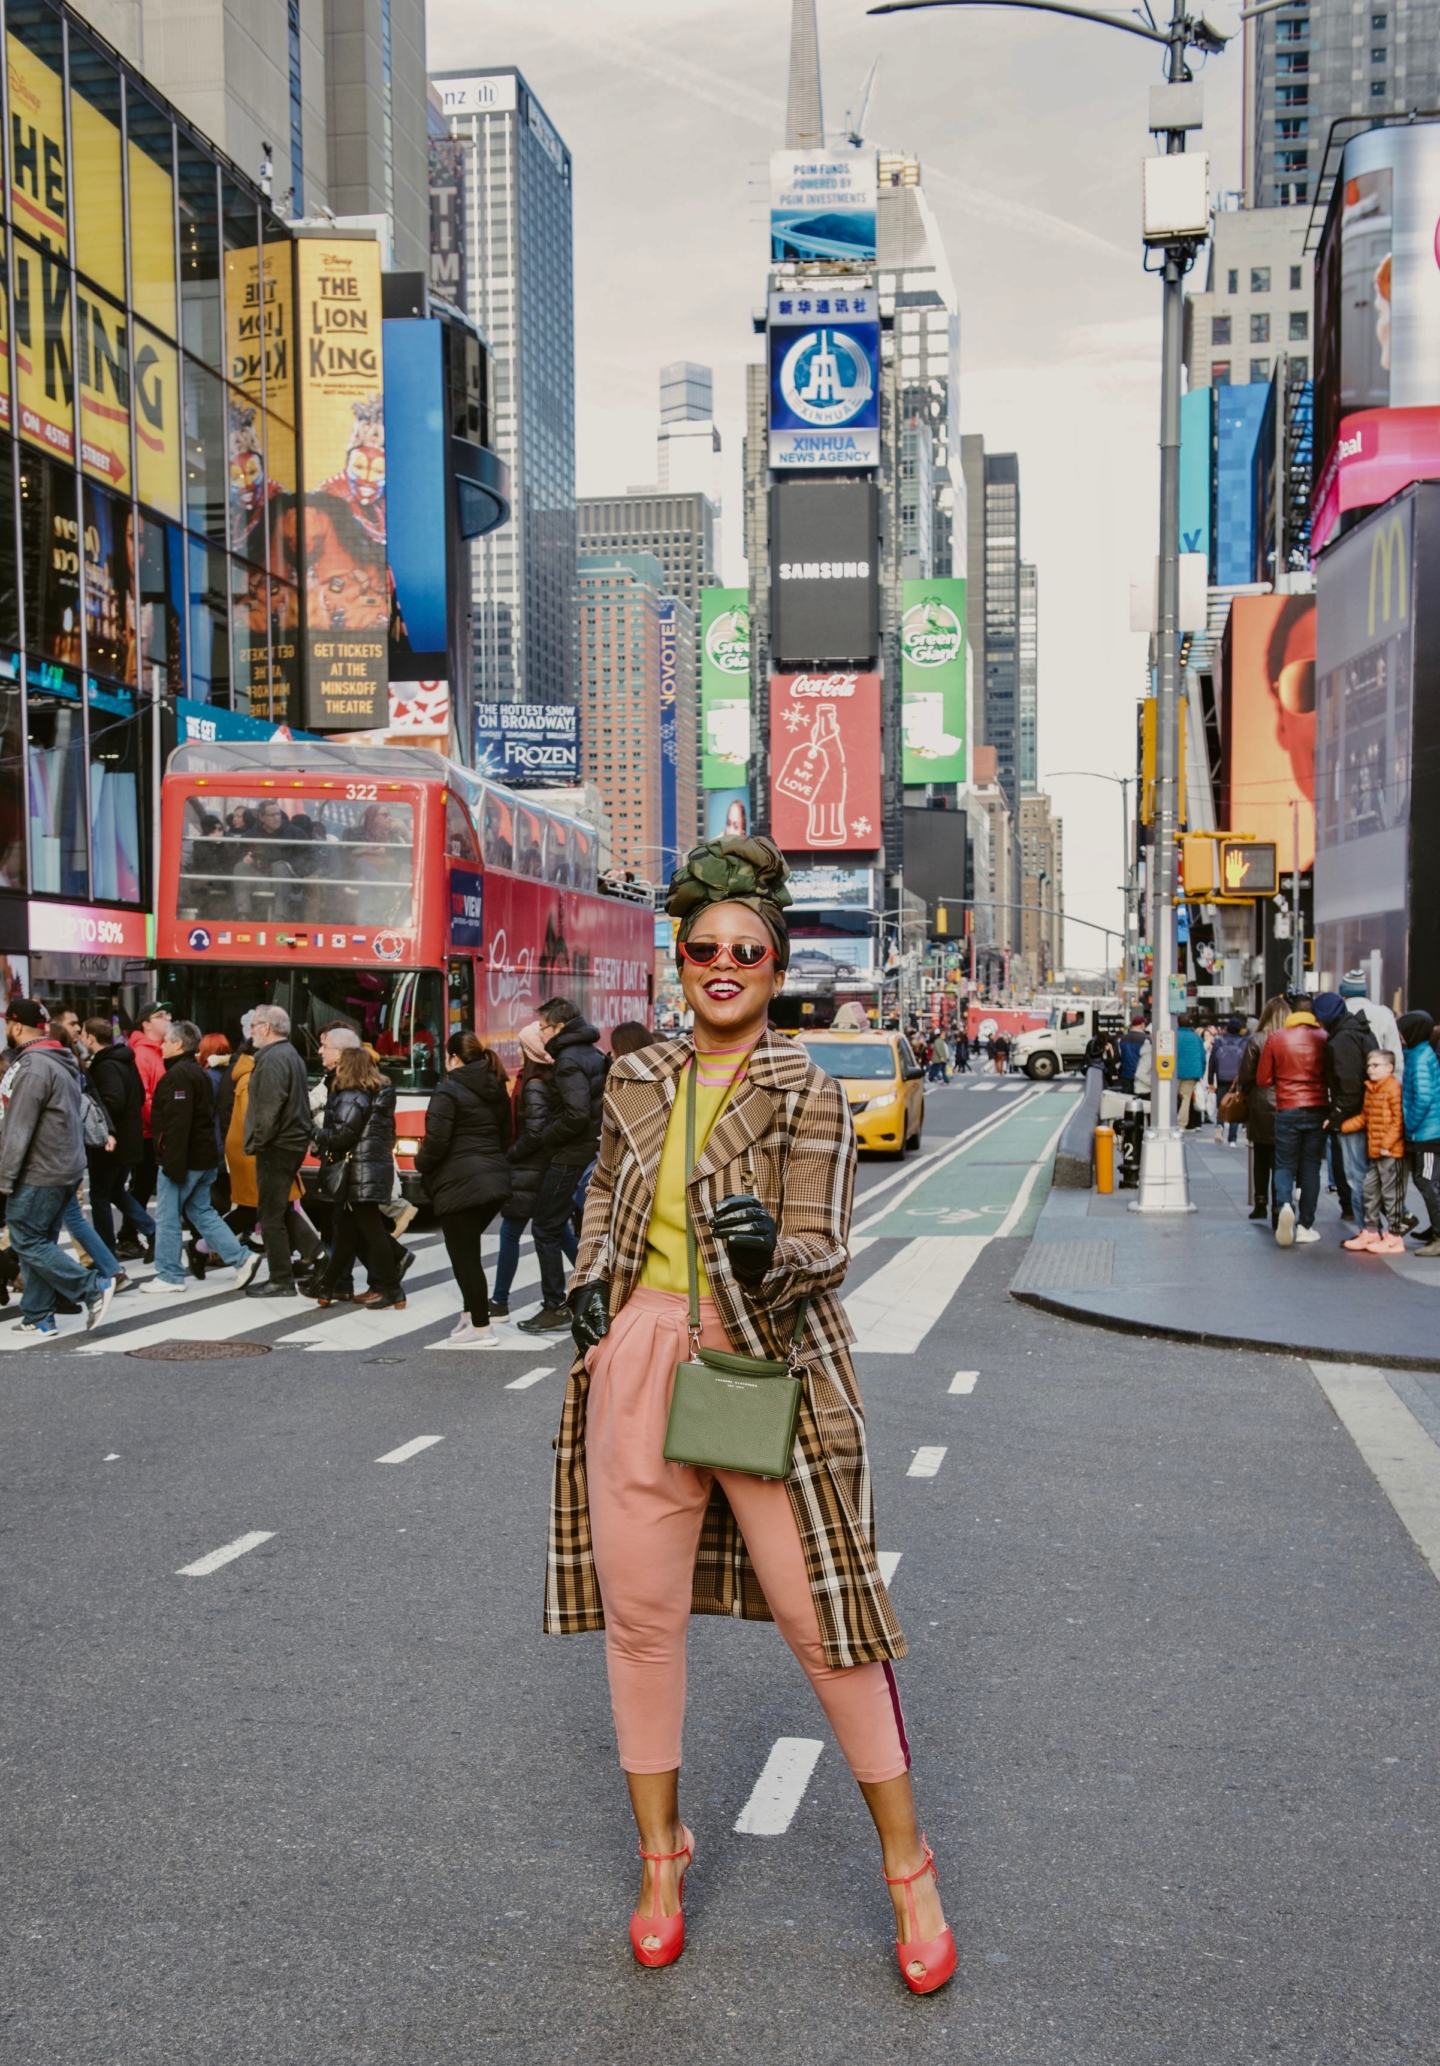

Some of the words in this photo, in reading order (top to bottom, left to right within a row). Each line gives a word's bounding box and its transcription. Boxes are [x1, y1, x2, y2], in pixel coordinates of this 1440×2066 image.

[318, 276, 358, 297] THE
[778, 298, 868, 315] 新华通讯社
[312, 300, 368, 335] LION
[309, 337, 377, 378] KING
[801, 404, 853, 422] XINHUA
[22, 410, 40, 434] ON
[44, 423, 71, 451] 45TH
[82, 443, 111, 473] STREET
[792, 435, 857, 451] XINHUA
[779, 452, 815, 463] NEWS
[819, 451, 871, 462] AGENCY
[778, 562, 870, 579] SAMSUNG
[713, 639, 750, 654] Gre
[904, 631, 958, 647] Green
[313, 643, 334, 658] GET
[337, 643, 382, 659] TICKETS
[911, 645, 960, 662] Giant
[659, 610, 677, 710] NOVOTEL
[719, 653, 750, 669] Gia
[330, 662, 343, 677] AT
[345, 662, 367, 677] THE
[320, 681, 377, 696] MINSKOFF
[325, 699, 373, 714] THEATRE
[480, 703, 499, 715] THE
[500, 704, 544, 716] HOTTEST
[545, 705, 576, 717] SNOW
[478, 714, 498, 729] ON
[501, 715, 577, 730] BROADWAY!
[504, 741, 577, 769] FROZEN
[793, 766, 813, 782] MY
[345, 784, 378, 801] 322
[783, 777, 813, 797] LOVE
[78, 919, 97, 943] TO
[97, 920, 124, 945] 50%
[79, 955, 110, 972] KIKO
[593, 956, 622, 990] EVERY
[622, 959, 639, 991] DAY
[592, 995, 620, 1028] BLACK
[620, 995, 649, 1027] FRIDAY
[1124, 1142, 1134, 1161] 2
